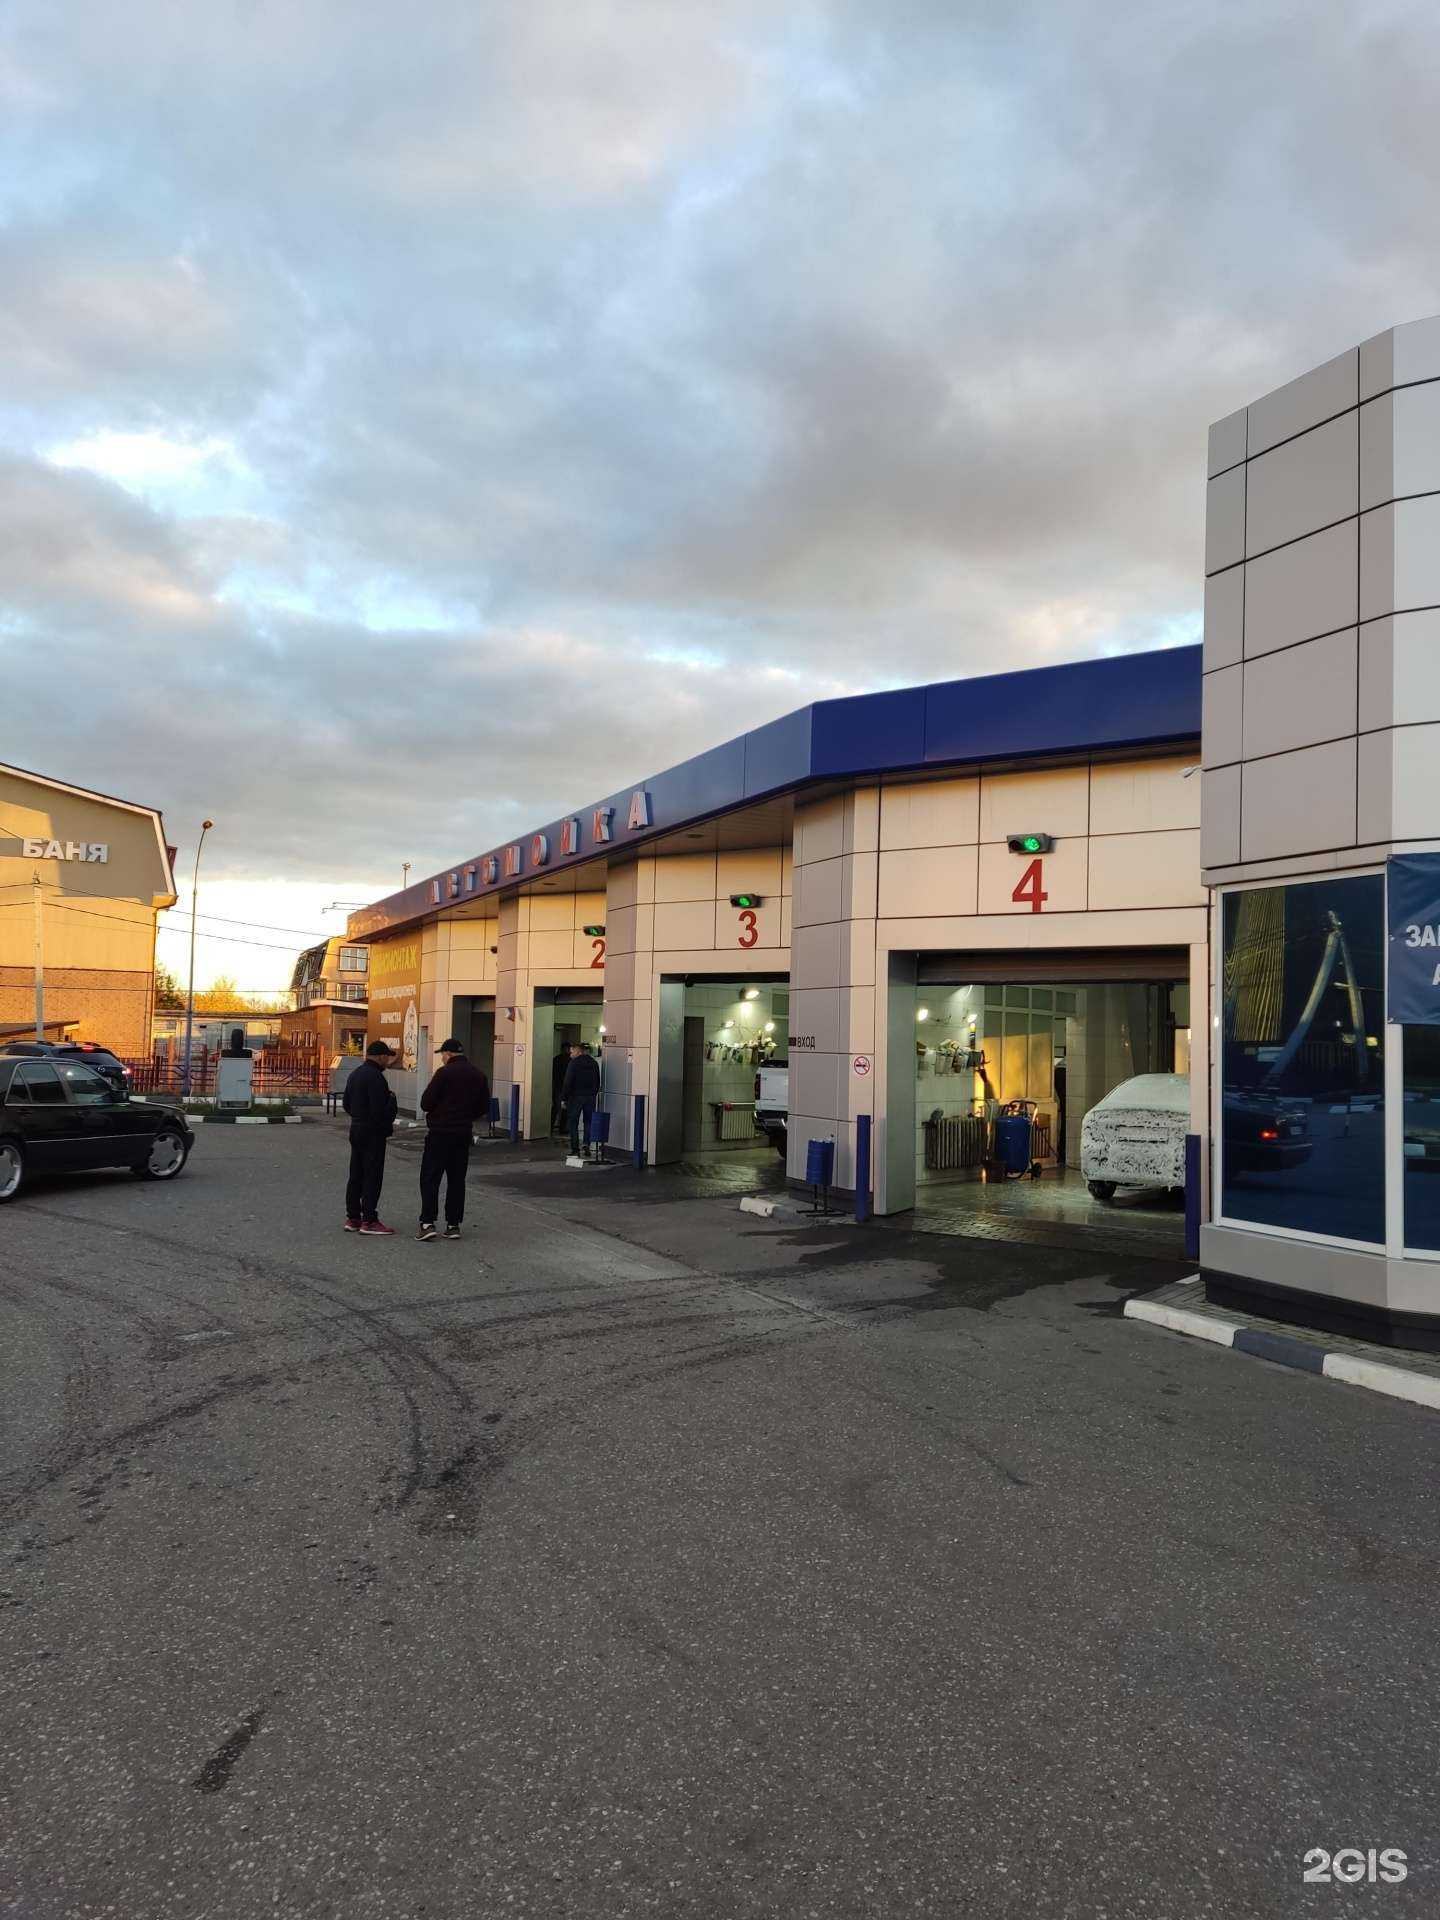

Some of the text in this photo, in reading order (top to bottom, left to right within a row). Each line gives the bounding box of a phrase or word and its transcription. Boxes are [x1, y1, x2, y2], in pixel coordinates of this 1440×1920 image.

[22, 838, 108, 864] БАНЯ
[1011, 858, 1049, 913] 4
[738, 910, 758, 948] 3
[1405, 924, 1440, 948] ЗА
[591, 939, 606, 969] 2
